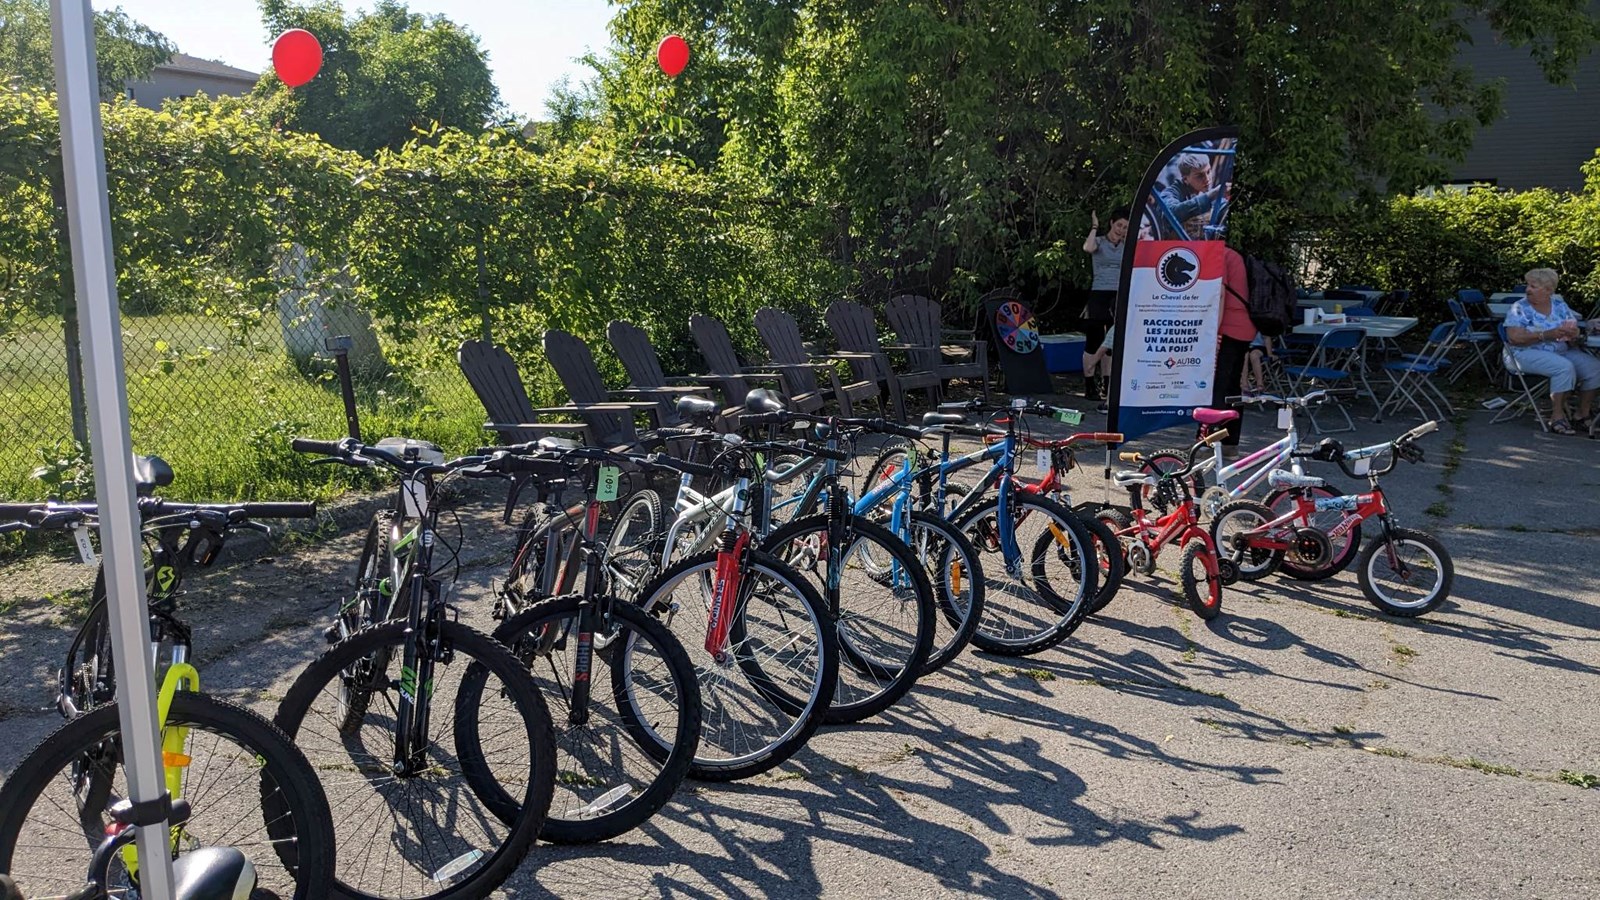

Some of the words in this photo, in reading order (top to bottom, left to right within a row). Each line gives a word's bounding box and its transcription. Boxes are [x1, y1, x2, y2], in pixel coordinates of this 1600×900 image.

[1003, 305, 1011, 315] 9
[1012, 304, 1019, 314] 0
[1027, 316, 1036, 329] 2
[1007, 335, 1015, 346] 6
[1029, 332, 1038, 341] 3
[1017, 341, 1023, 351] 5
[1024, 340, 1032, 350] 4
[1146, 344, 1153, 352] À
[1168, 345, 1188, 353] FOIS
